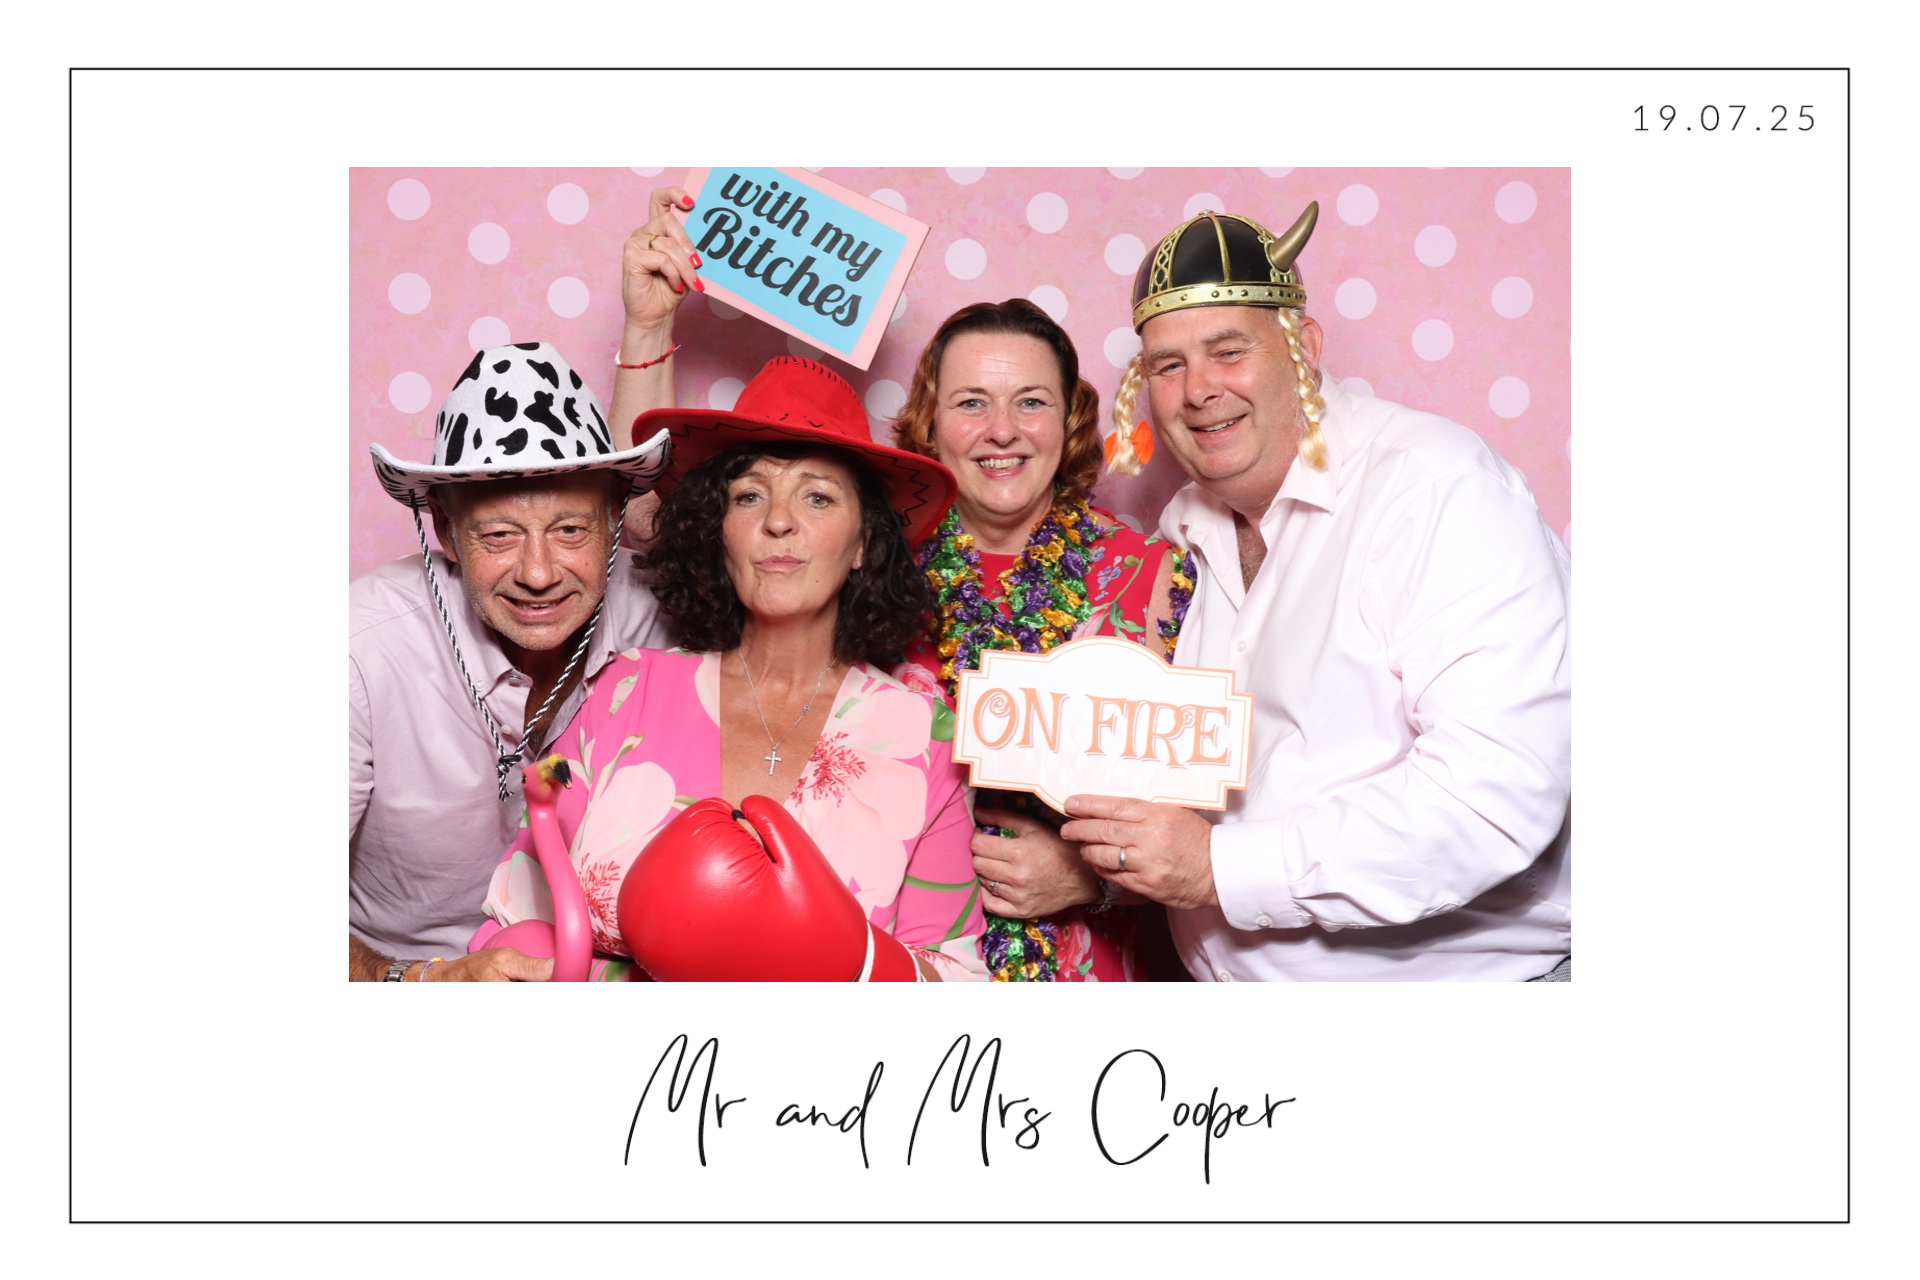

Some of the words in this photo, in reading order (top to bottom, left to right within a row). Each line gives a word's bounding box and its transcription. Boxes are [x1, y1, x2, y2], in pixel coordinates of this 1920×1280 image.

[695, 206, 863, 327] Bitches
[719, 172, 811, 238] with
[810, 221, 883, 283] my
[972, 686, 1071, 754] ON
[1083, 693, 1232, 769] FIRE
